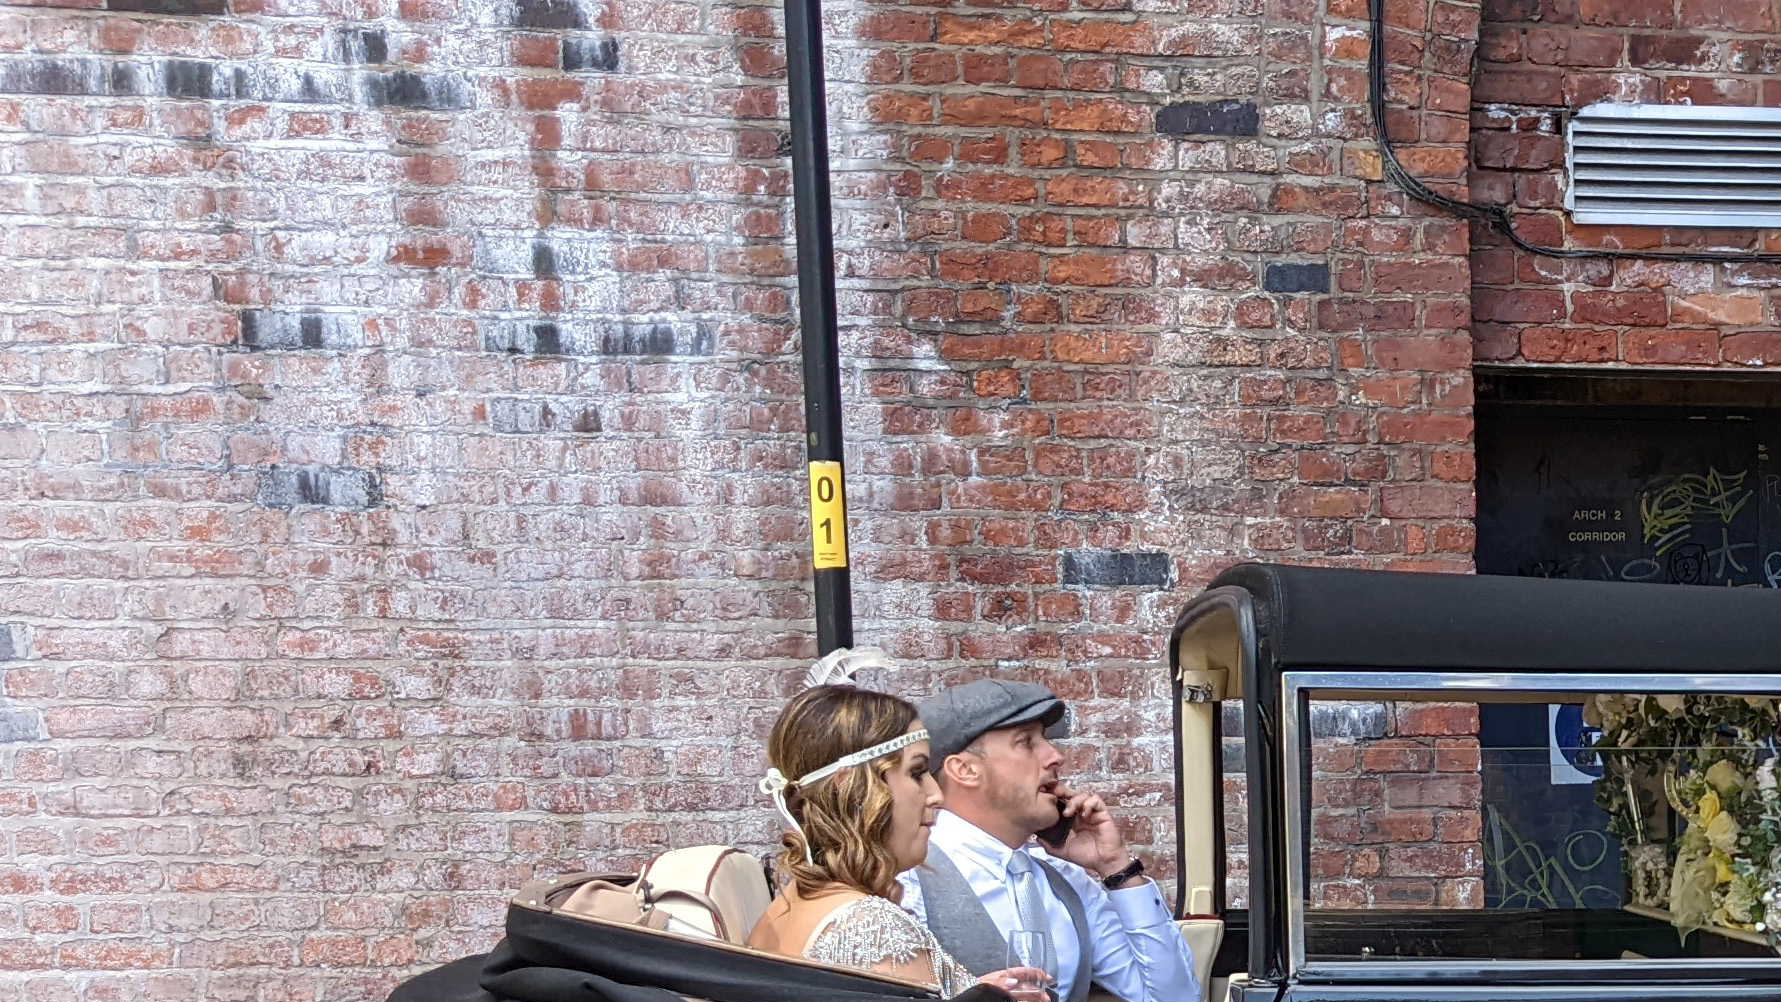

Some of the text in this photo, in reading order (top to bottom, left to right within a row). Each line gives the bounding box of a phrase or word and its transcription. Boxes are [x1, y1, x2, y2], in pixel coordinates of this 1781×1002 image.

[1573, 510, 1622, 521] ARCH 2
[1568, 531, 1626, 542] CORRIDOR
